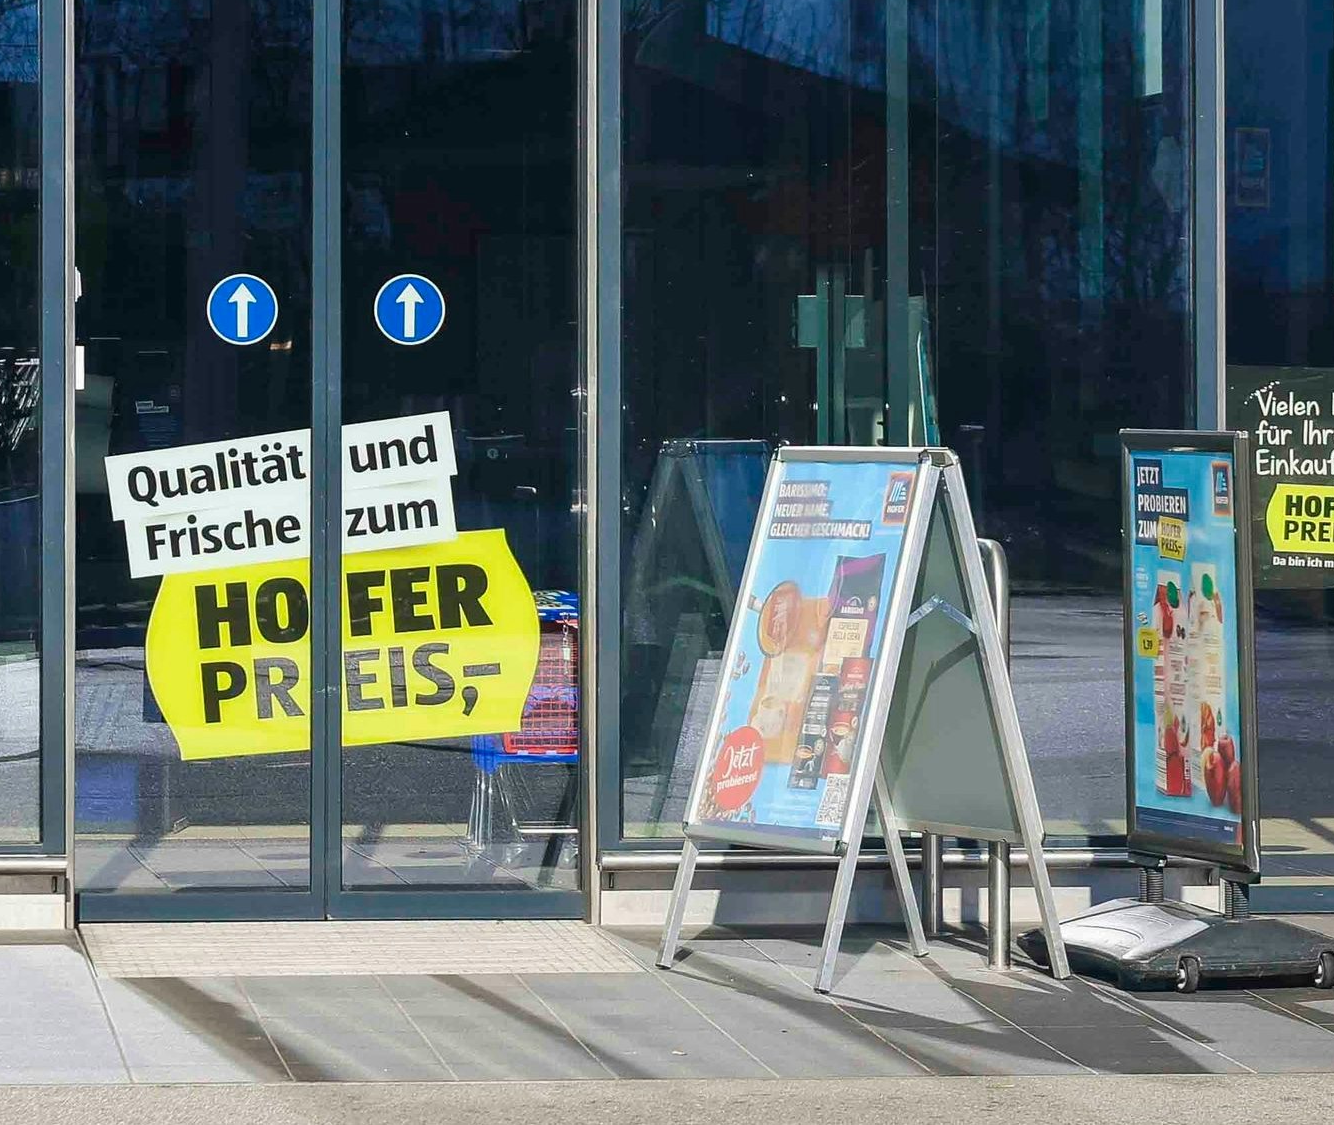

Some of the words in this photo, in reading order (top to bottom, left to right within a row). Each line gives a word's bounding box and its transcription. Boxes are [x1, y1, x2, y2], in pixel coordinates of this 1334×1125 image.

[1255, 390, 1321, 417] Vielen
[1255, 420, 1293, 446] für
[127, 441, 307, 503] Qualität
[349, 424, 439, 473] und
[1136, 466, 1160, 487] JETZT
[774, 503, 802, 518] NEUER
[886, 505, 906, 514] HOFER
[1137, 493, 1187, 514] PROBIEREN
[145, 510, 302, 561] Frische
[345, 497, 439, 537] zum
[770, 522, 812, 537] GLEICHER
[812, 523, 871, 537] GESCHMACK!
[1138, 520, 1158, 539] ZUM
[1160, 520, 1182, 539] HOFER
[1272, 555, 1287, 567] Da
[1287, 555, 1305, 568] bin
[1306, 555, 1323, 568] ich
[722, 742, 761, 779] Jetzt
